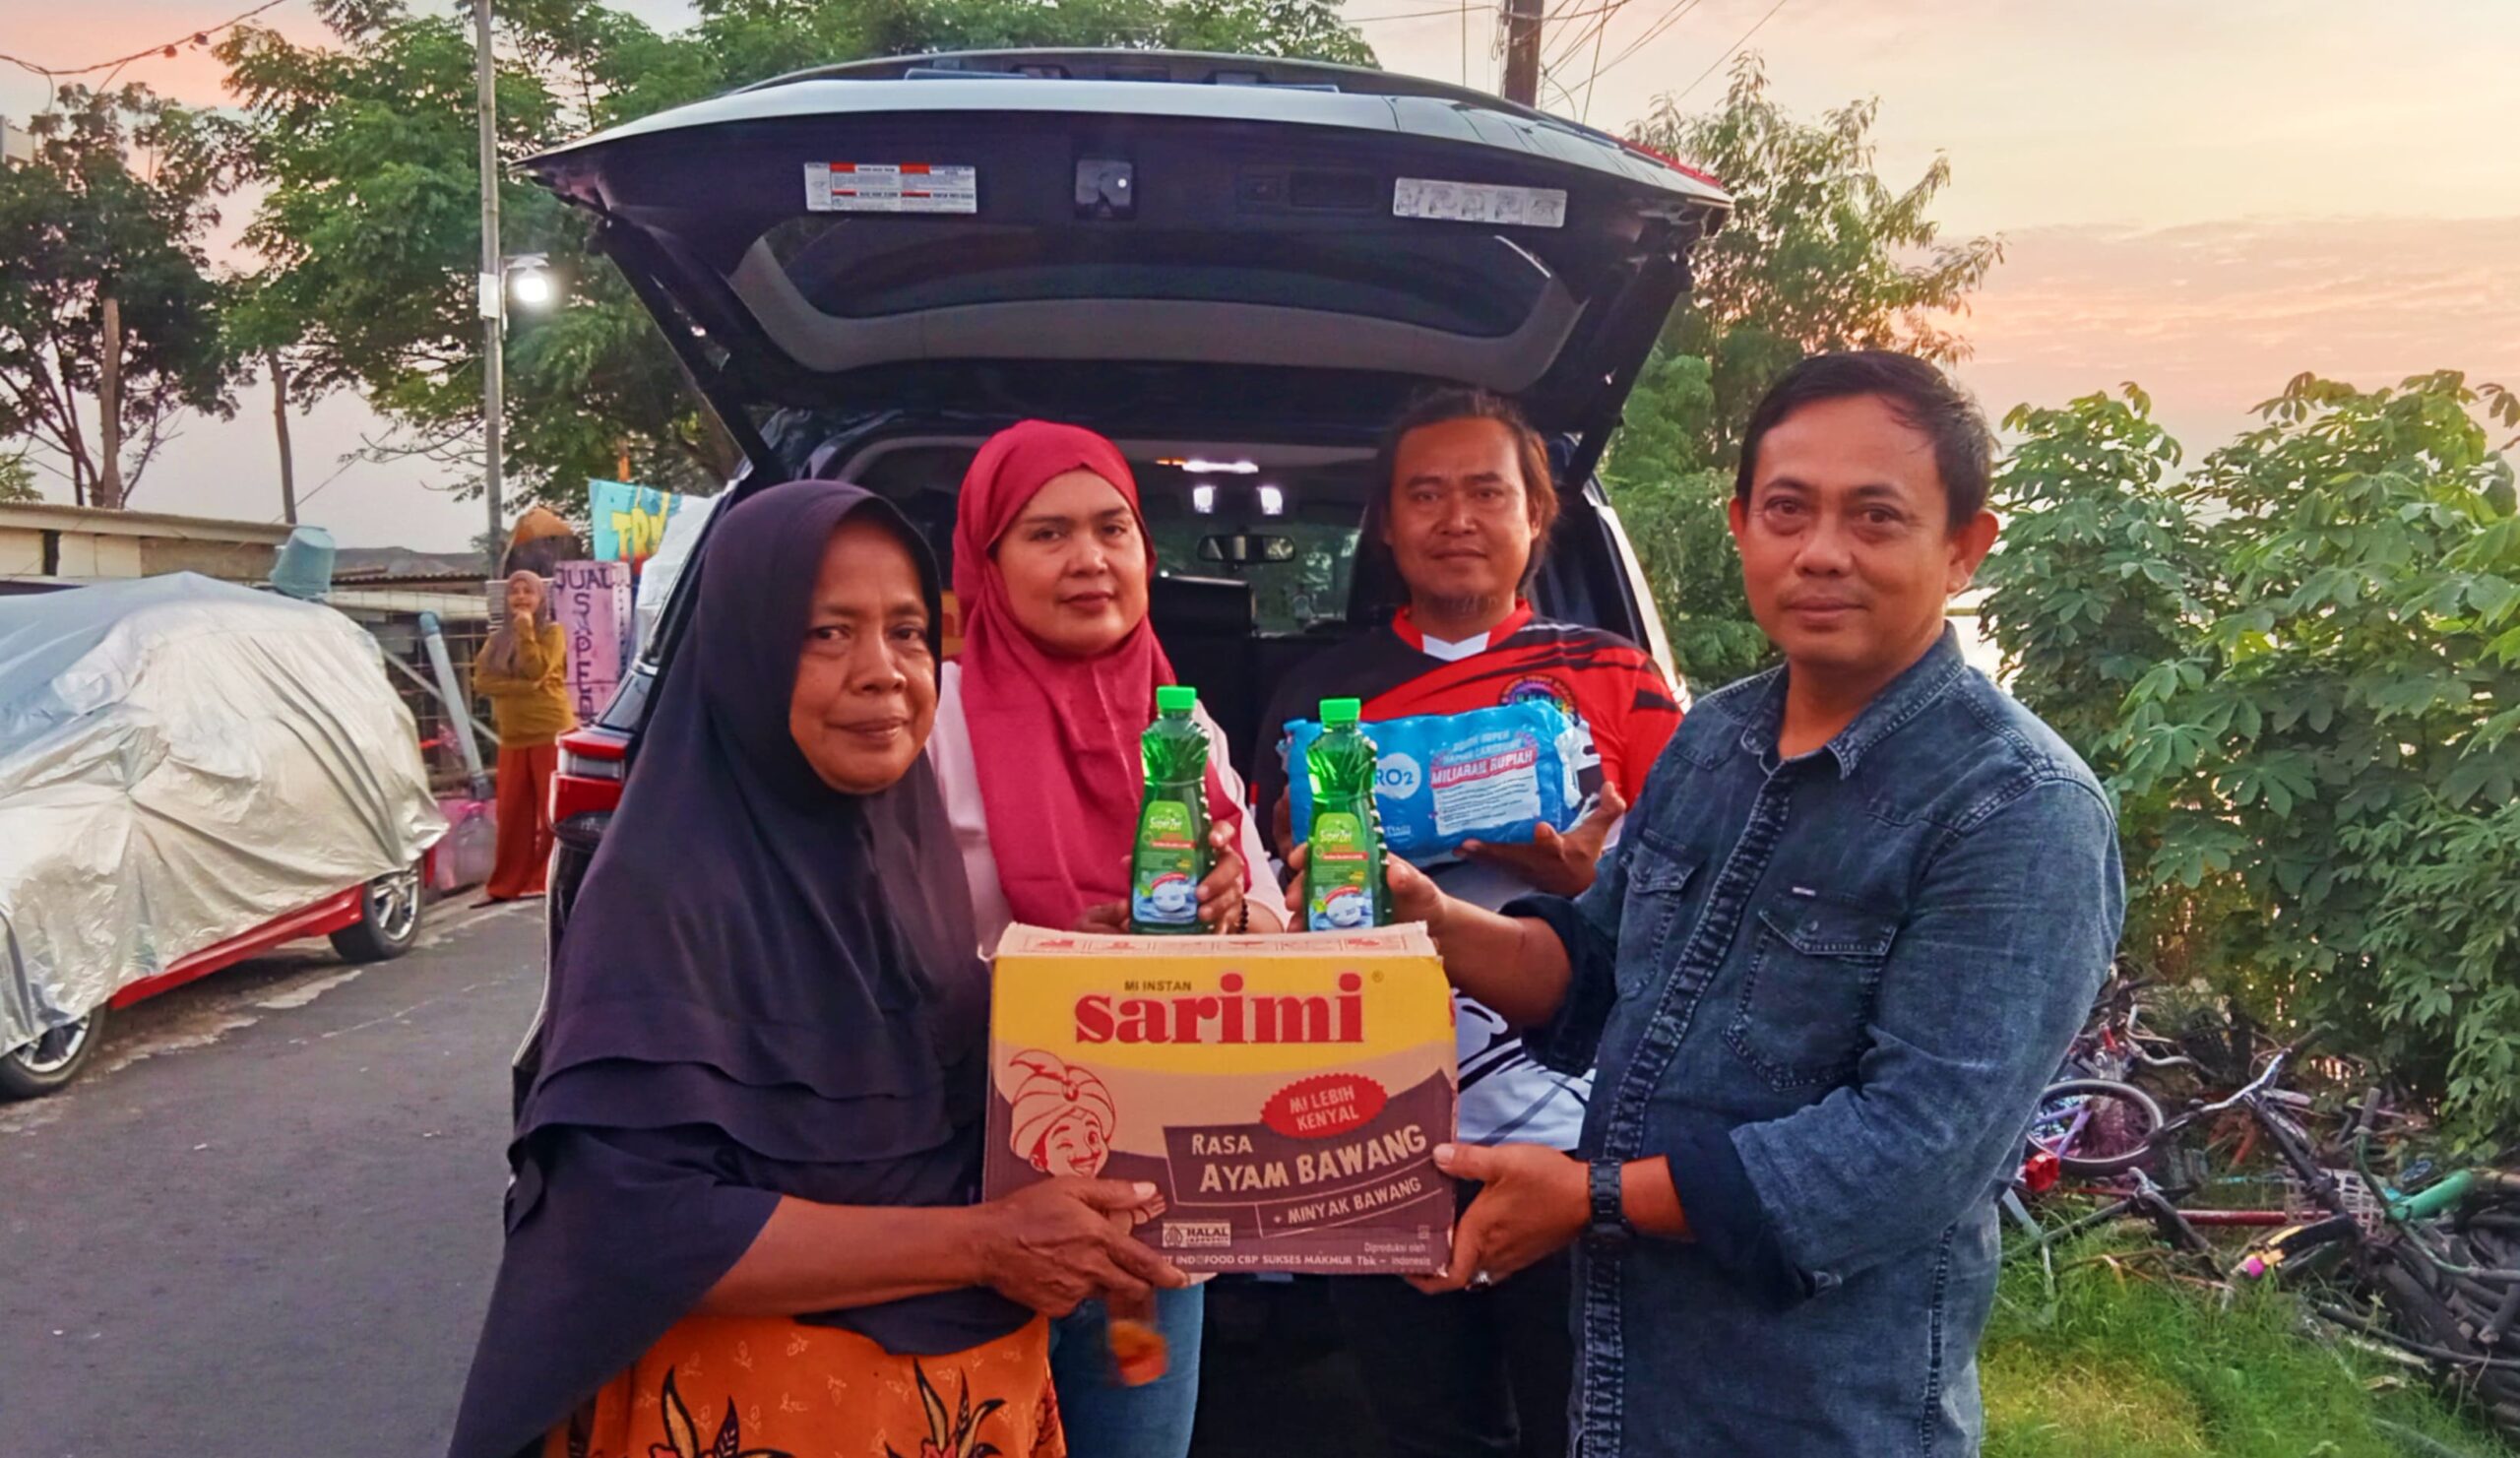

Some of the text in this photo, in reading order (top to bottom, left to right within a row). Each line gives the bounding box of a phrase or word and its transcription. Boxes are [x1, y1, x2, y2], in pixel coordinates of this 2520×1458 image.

[555, 569, 614, 591] JUAL
[1488, 749, 1534, 774] RUPIAH
[1124, 981, 1192, 991] MI INSTAN
[1074, 973, 1364, 1045] sarimi
[1290, 1085, 1355, 1114] MI LEBIH
[1295, 1104, 1359, 1131] KENYAL
[1192, 1134, 1253, 1156] RASA
[1199, 1124, 1426, 1192] AYAM BAWANG
[1288, 1176, 1422, 1224] MINYAK BAWANG
[1186, 1228, 1228, 1236] HALAL
[1364, 1242, 1406, 1253] Diproduksi
[1176, 1254, 1234, 1265] INDOFOOD
[1237, 1254, 1259, 1265] CBP
[1263, 1254, 1301, 1265] SUKSES
[1304, 1254, 1352, 1266] MAKMUR
[1357, 1255, 1377, 1266] Tbk
